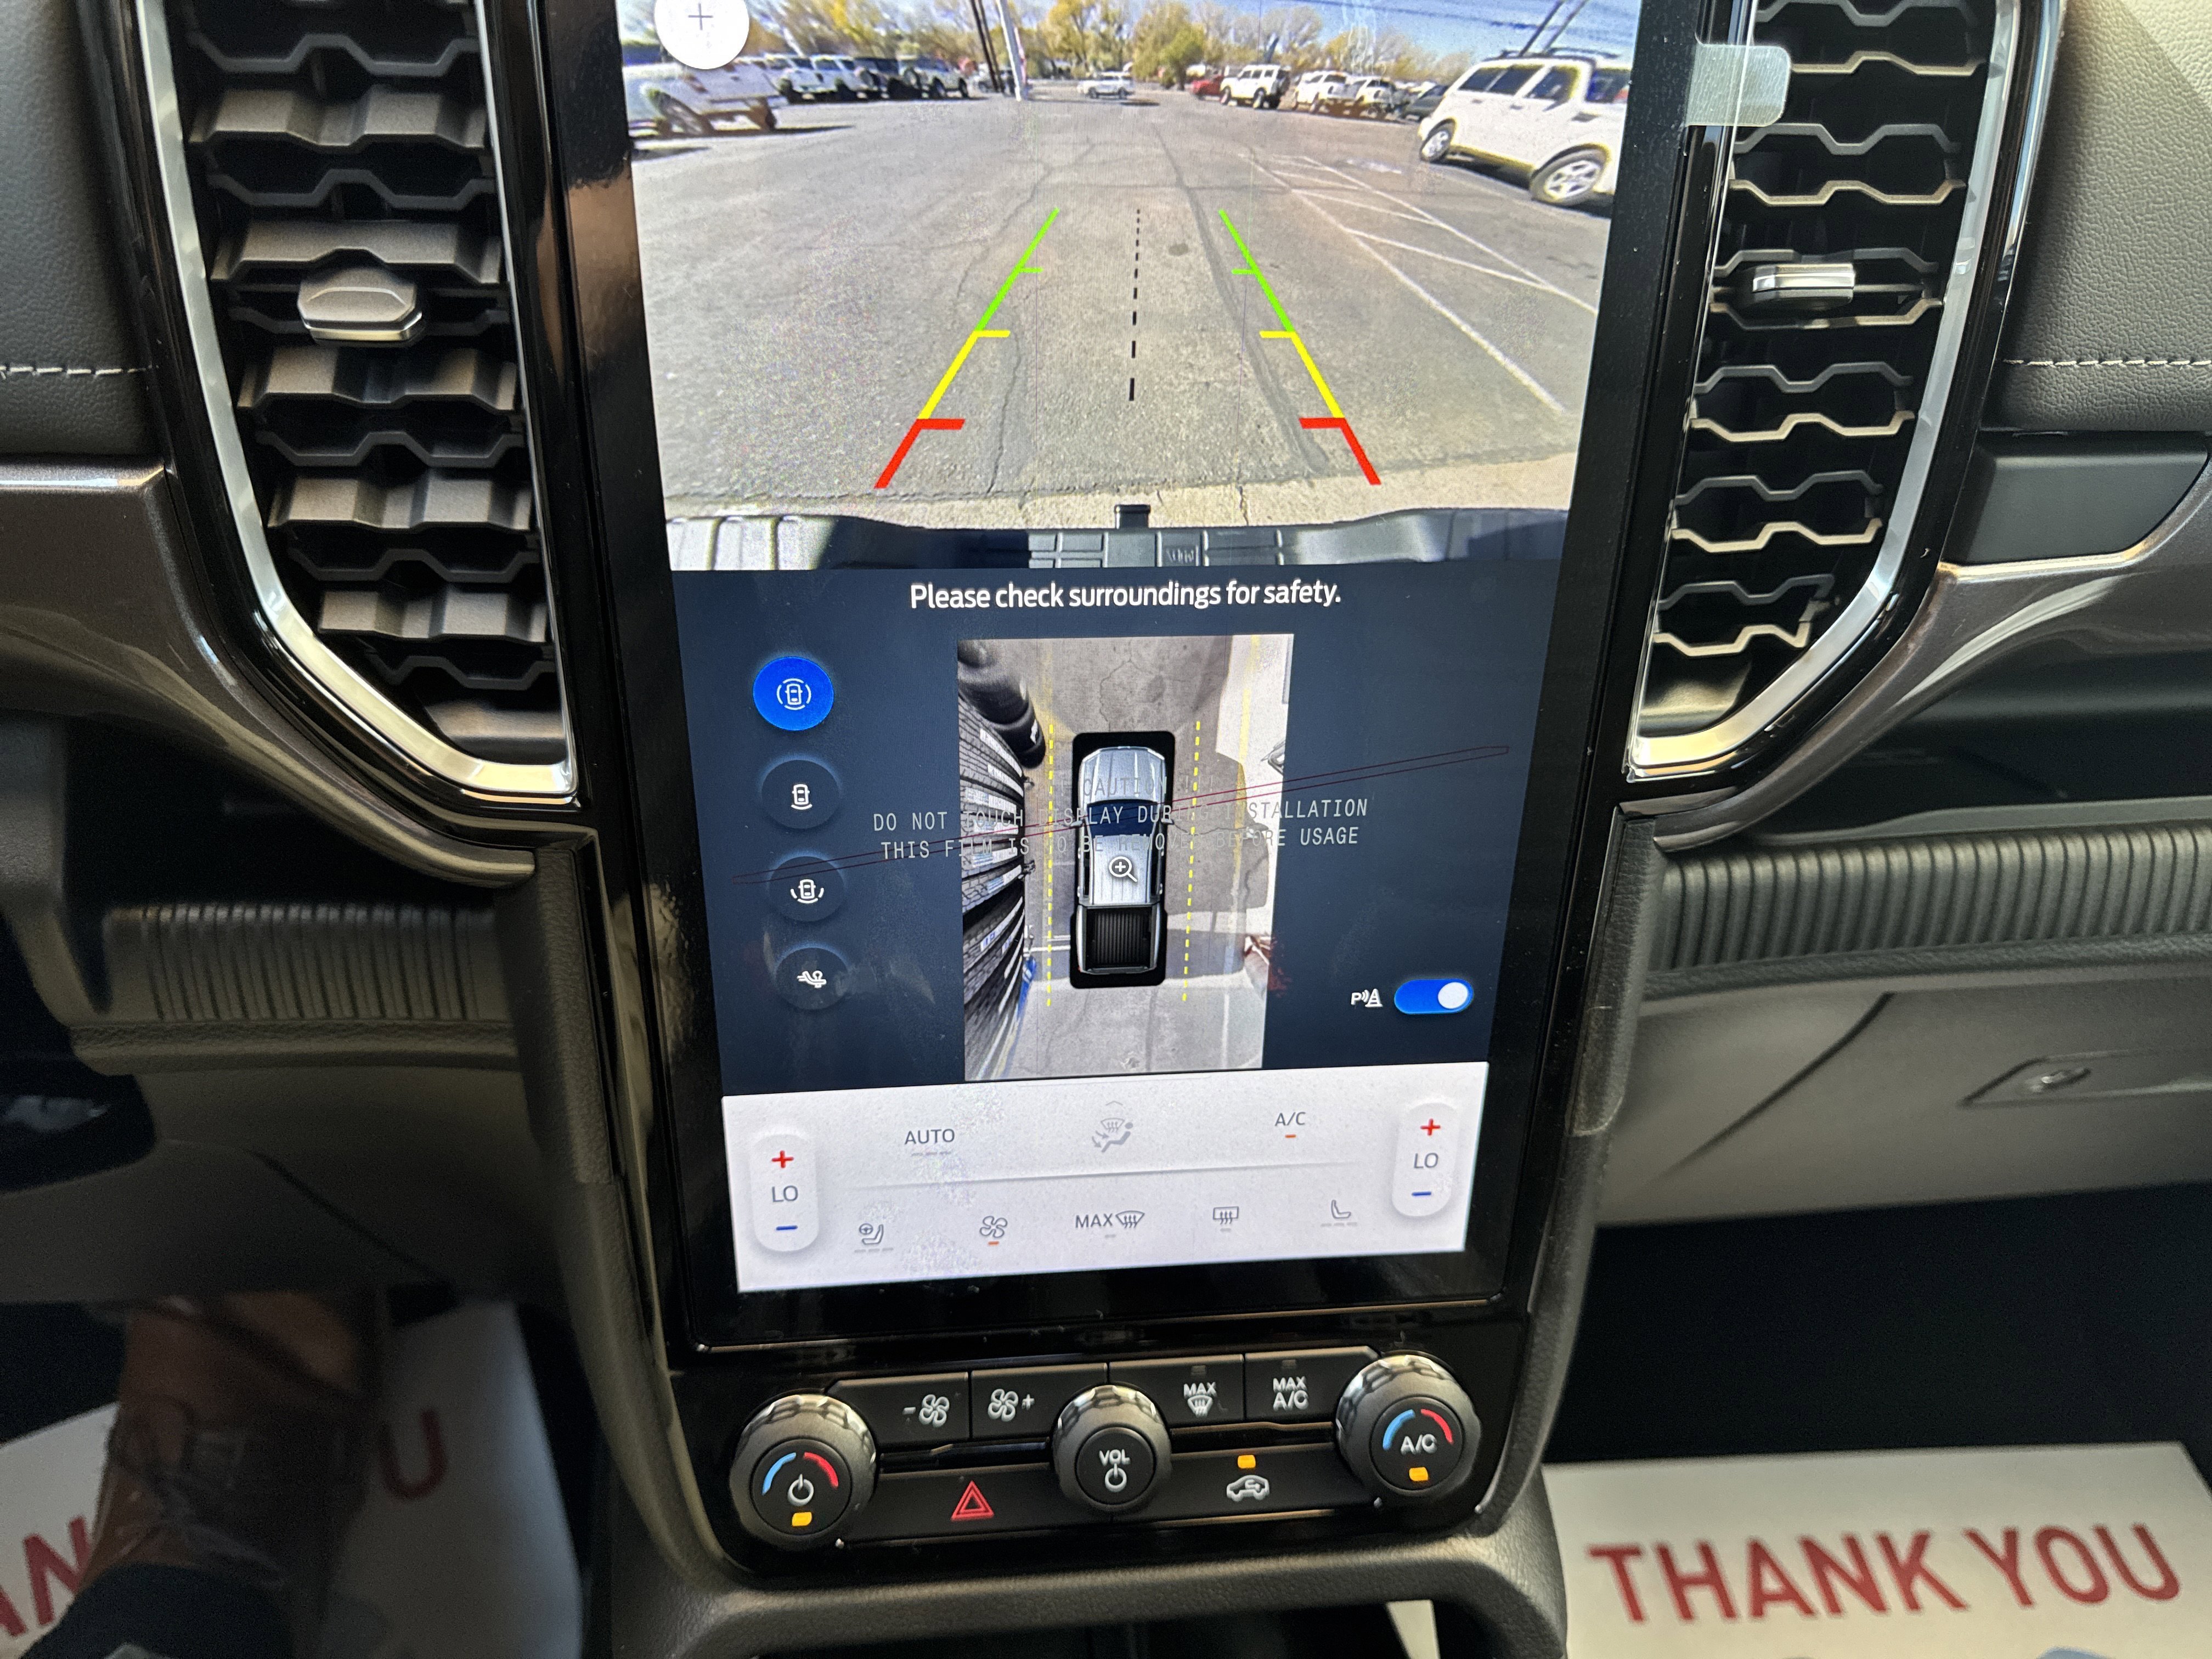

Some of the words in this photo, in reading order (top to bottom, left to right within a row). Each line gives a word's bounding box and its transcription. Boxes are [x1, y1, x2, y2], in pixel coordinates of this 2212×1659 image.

[910, 583, 991, 608] Please
[995, 581, 1062, 608] check
[1069, 581, 1221, 609] surroundings
[1226, 579, 1260, 605] for
[1263, 579, 1341, 607] safety.
[1083, 777, 1167, 795] CAUTION
[873, 812, 897, 832] DO
[912, 811, 948, 831] NOT
[962, 809, 1024, 829] TOUCH
[1039, 806, 1124, 826] DISPLAY
[1224, 798, 1368, 821] ISTALLATION
[881, 840, 930, 860] THIS
[945, 838, 992, 857] FILM
[1008, 837, 1029, 856] IS
[1082, 834, 1104, 852] BE
[1216, 829, 1287, 849] BEFORE
[1300, 826, 1359, 847] USAGE
[1274, 1111, 1306, 1126] A/C
[904, 1128, 956, 1145] AUTO
[1413, 1152, 1440, 1170] LO
[771, 1184, 799, 1203] LO
[1075, 1212, 1114, 1229] MAX
[1183, 1382, 1217, 1398] MAX
[1272, 1375, 1308, 1392] MAX
[1272, 1389, 1310, 1412] A/C
[1400, 1434, 1438, 1455] A/C
[1098, 1449, 1131, 1466] VOL
[1587, 1528, 1970, 1624] THANK
[1964, 1523, 2182, 1607] YOU
